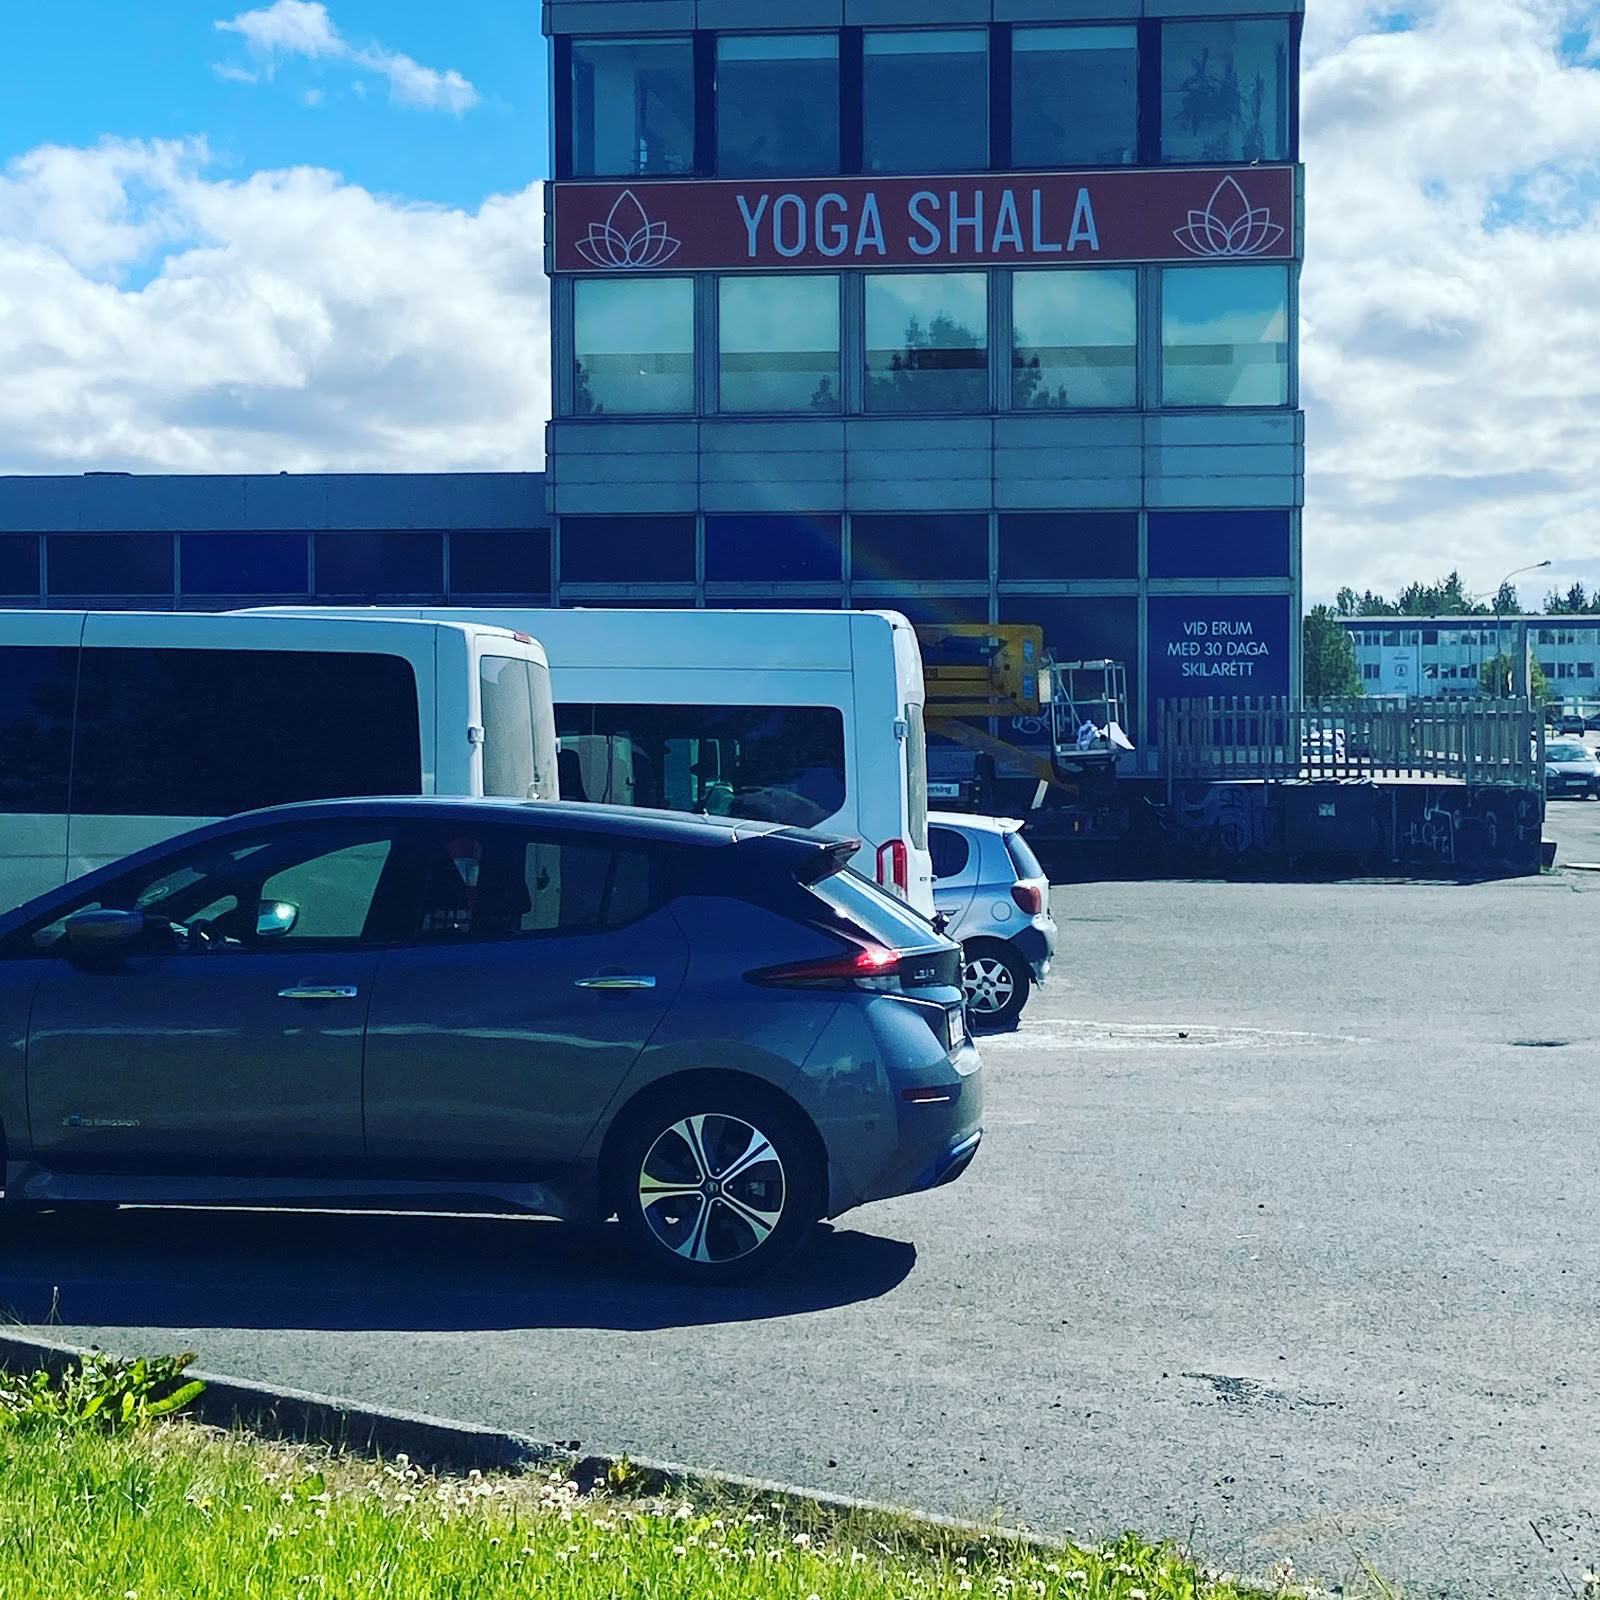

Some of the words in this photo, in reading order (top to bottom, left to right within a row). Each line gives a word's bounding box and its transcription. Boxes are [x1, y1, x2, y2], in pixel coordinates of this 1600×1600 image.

[736, 193, 887, 258] YOGA
[907, 188, 1100, 255] SHALA
[1211, 621, 1253, 636] ERUM
[1204, 641, 1223, 656] 30
[1226, 641, 1270, 656] DAGA
[1181, 660, 1254, 677] SKILARÉTT
